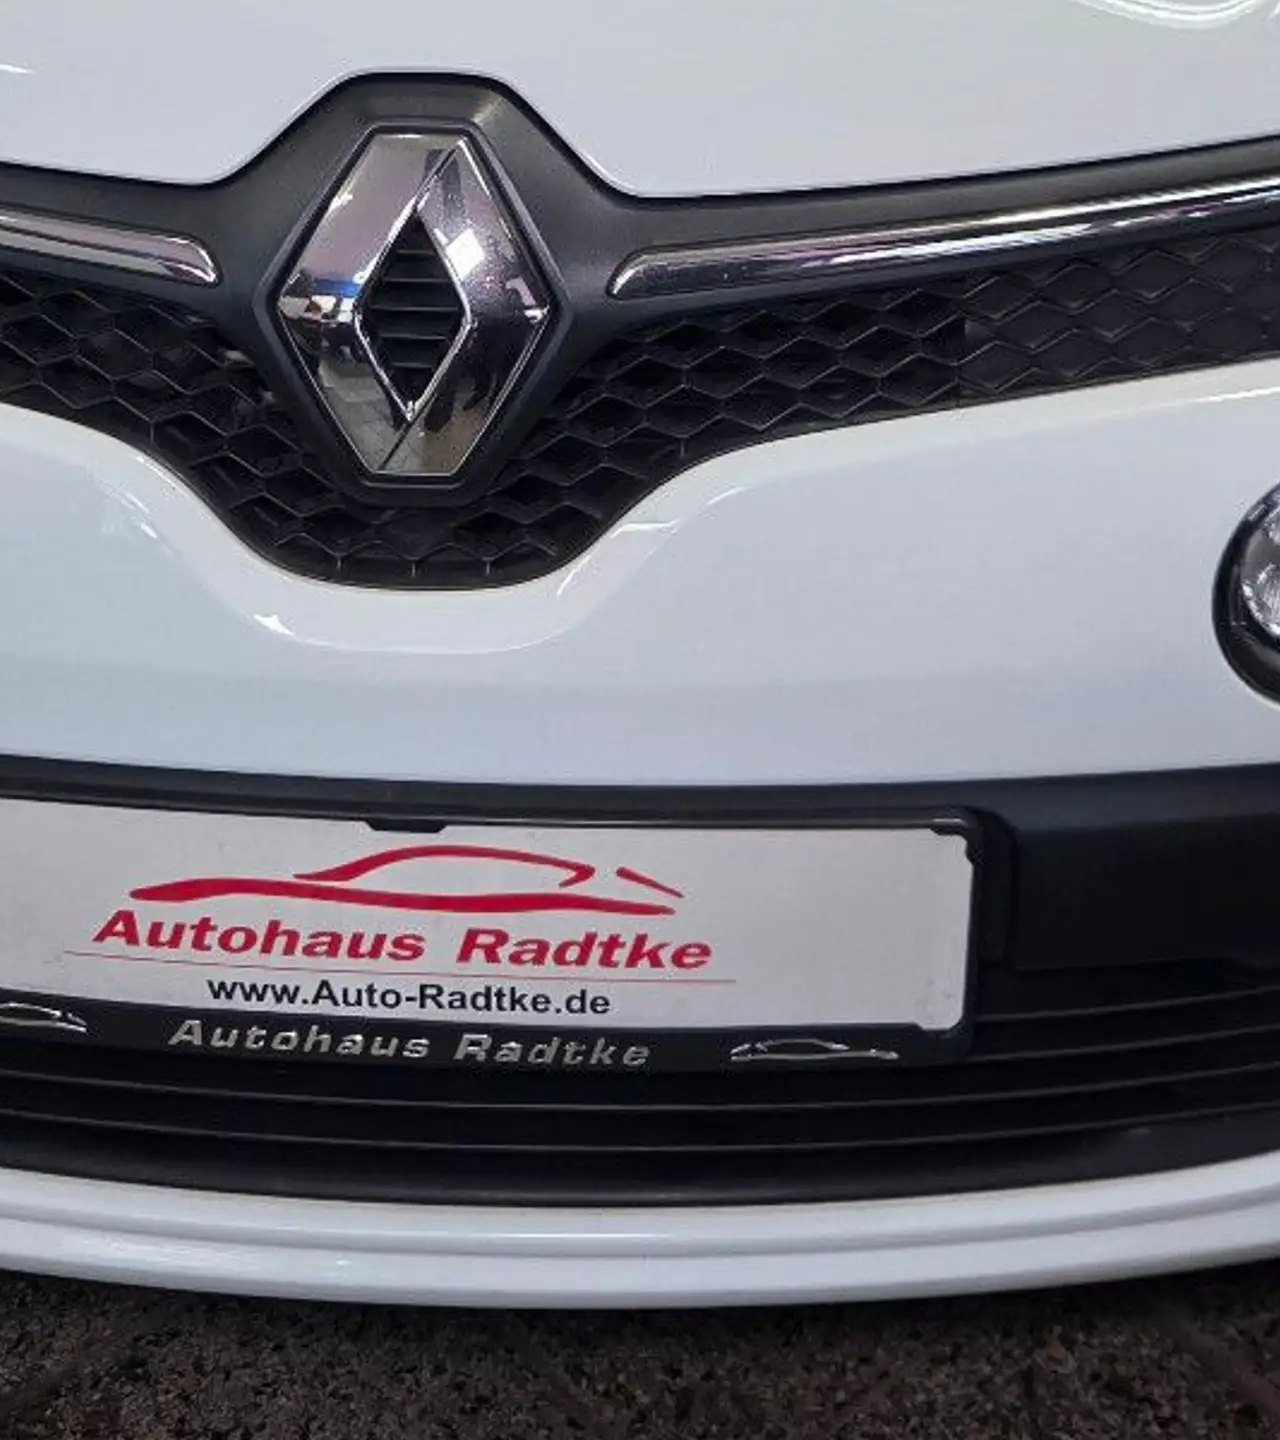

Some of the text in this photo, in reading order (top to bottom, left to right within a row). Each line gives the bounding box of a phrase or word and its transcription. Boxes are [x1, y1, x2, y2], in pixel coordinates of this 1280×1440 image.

[92, 910, 712, 970] Autohaus Radtke
[207, 979, 611, 1015] www.Auto-Radtke.de
[168, 1019, 650, 1065] Autohaus Radtke
